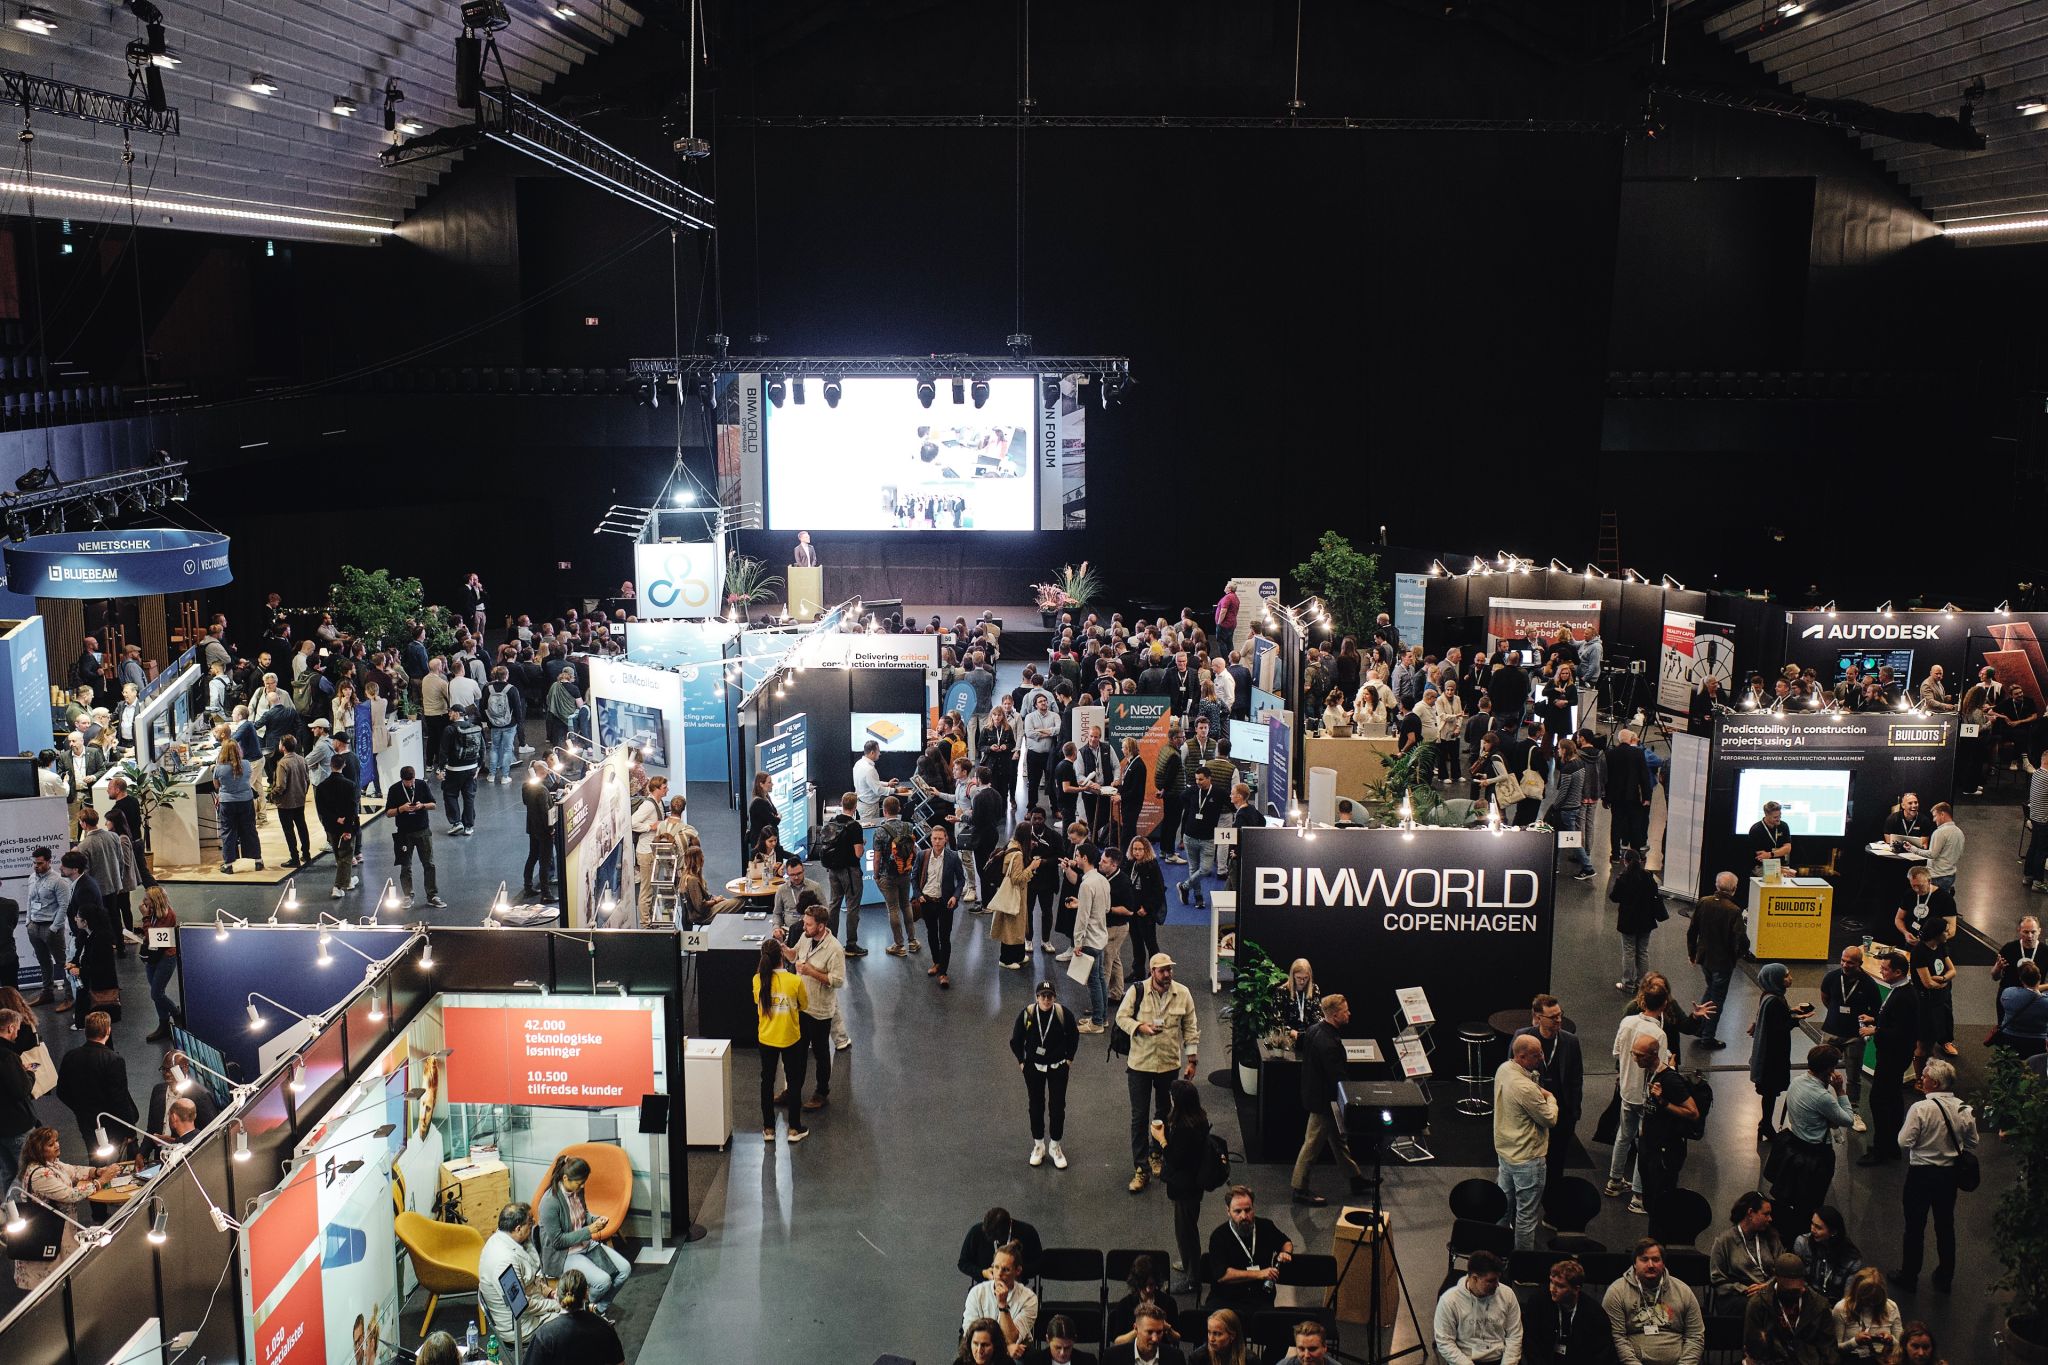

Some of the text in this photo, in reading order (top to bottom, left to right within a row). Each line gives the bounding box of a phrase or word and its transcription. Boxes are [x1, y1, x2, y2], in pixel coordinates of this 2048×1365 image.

[746, 388, 758, 453] BIMWORLD
[1045, 423, 1056, 468] FORUM
[77, 540, 151, 552] NEMETSCHEK
[64, 567, 118, 580] BLUEBEAM
[1515, 619, 1526, 628] Få
[1666, 628, 1683, 636] REALITY
[1828, 624, 1941, 640] AUTODESK
[855, 653, 930, 662] Delivering critical
[877, 660, 930, 669] information.
[930, 670, 938, 678] 40
[622, 672, 660, 689] BIMcollab
[956, 692, 968, 713] RIB
[701, 714, 715, 722] your
[1722, 724, 1867, 736] Predictability in construction
[1895, 729, 1940, 741] BUILDOTS
[1721, 736, 1805, 748] projects using AI
[42, 833, 64, 842] HVAC
[1220, 832, 1231, 841] 14
[1254, 866, 1540, 908] BIMWORLD
[1774, 901, 1816, 912] BUILDOTS
[1383, 913, 1538, 932] COPENHAGEN
[156, 932, 169, 942] 32
[687, 936, 700, 945] 24
[523, 1019, 566, 1031] 42.000
[525, 1032, 603, 1046] teknologiske
[526, 1045, 581, 1059] løsninger
[527, 1071, 568, 1082] 10.500
[527, 1083, 624, 1096] tilfredse kunder
[265, 1326, 285, 1361] 1.050
